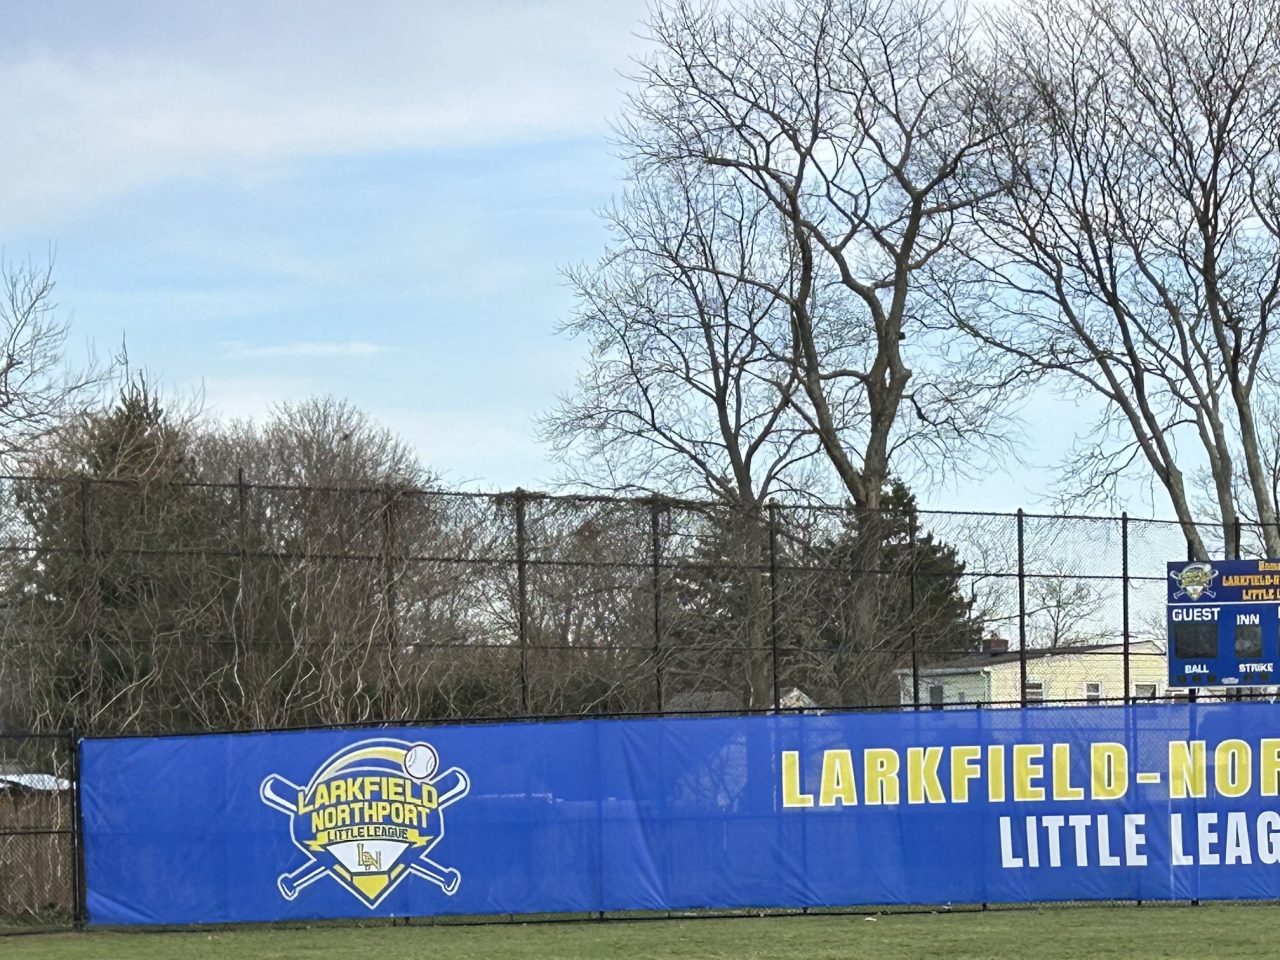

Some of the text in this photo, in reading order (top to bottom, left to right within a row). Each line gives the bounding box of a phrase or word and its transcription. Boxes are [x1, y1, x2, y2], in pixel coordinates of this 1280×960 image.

[1242, 589, 1275, 600] LITTLE
[1172, 607, 1221, 622] GUEST
[1236, 614, 1260, 625] INN
[1184, 664, 1209, 674] BALL
[1238, 663, 1274, 673] STRIKE
[297, 776, 439, 816] LARKFIELD
[311, 801, 431, 833] NORTHPORT
[327, 826, 409, 842] LITTLE LEAGUE
[999, 813, 1148, 868] LITTLE
